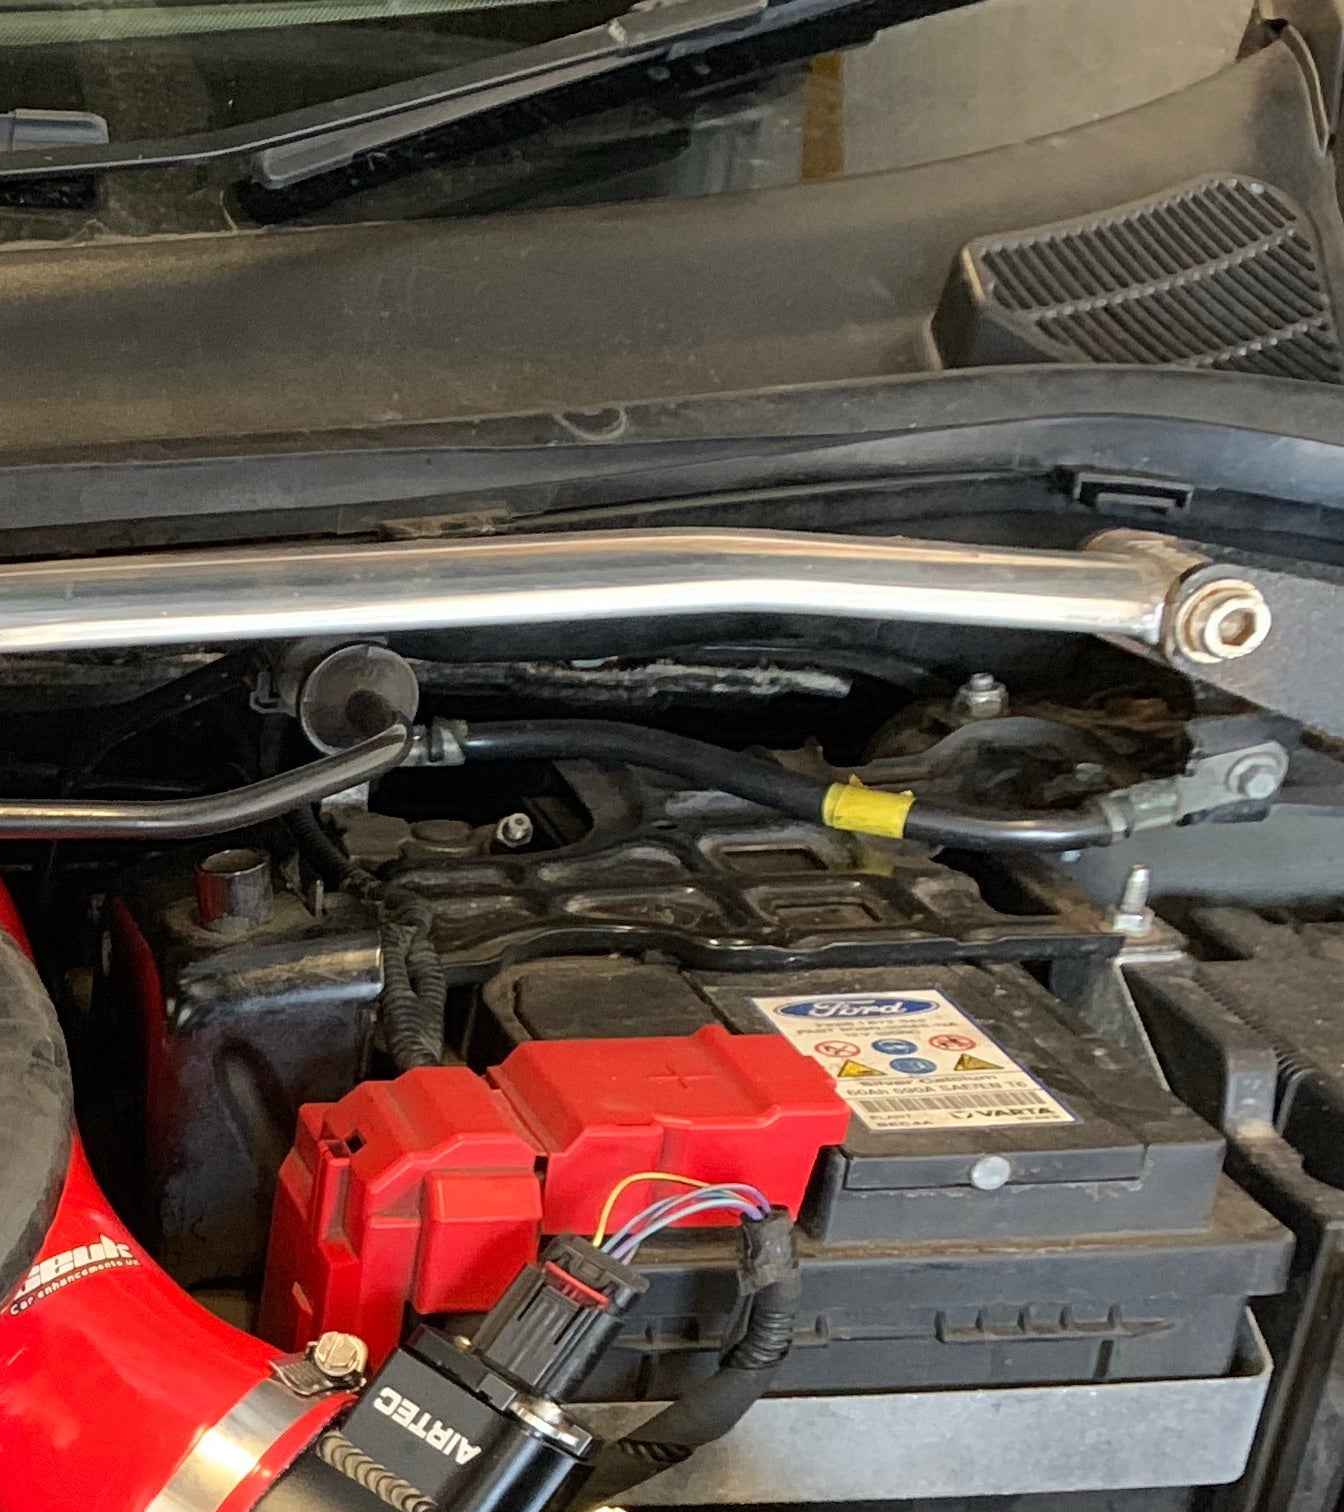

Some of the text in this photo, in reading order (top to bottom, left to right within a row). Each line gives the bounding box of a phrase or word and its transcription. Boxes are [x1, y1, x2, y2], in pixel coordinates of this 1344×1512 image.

[809, 999, 907, 1018] Ford
[974, 1107, 1055, 1118] VARTA
[10, 1296, 34, 1316] Car
[37, 1259, 124, 1299] enhancements
[373, 1386, 482, 1466] AIRTEC
